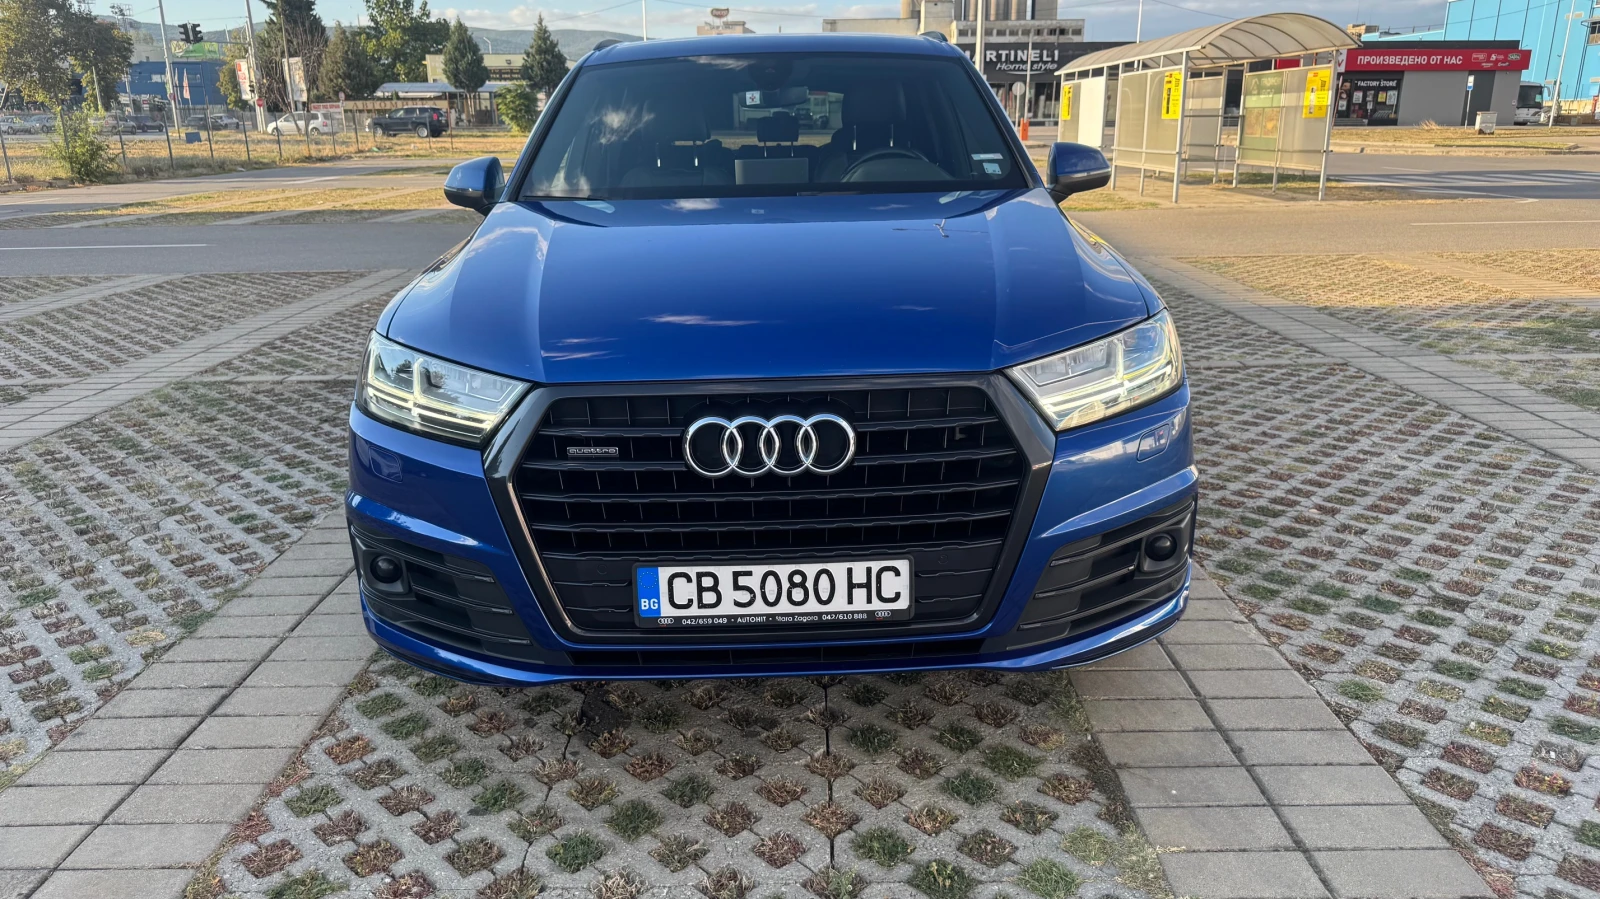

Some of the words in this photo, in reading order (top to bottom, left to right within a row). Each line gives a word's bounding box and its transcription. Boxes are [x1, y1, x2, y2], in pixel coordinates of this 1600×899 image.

[1357, 56, 1428, 66] ПРОИЗВЕДЕНО
[1430, 56, 1442, 65] ОТ
[1444, 56, 1463, 65] НАС
[995, 62, 1028, 71] Home
[1032, 62, 1058, 71] style
[667, 571, 723, 609] CB
[732, 568, 836, 609] 5080
[847, 565, 901, 605] HC
[641, 598, 659, 610] BG
[822, 613, 852, 621] 042/610
[853, 612, 867, 620] 888
